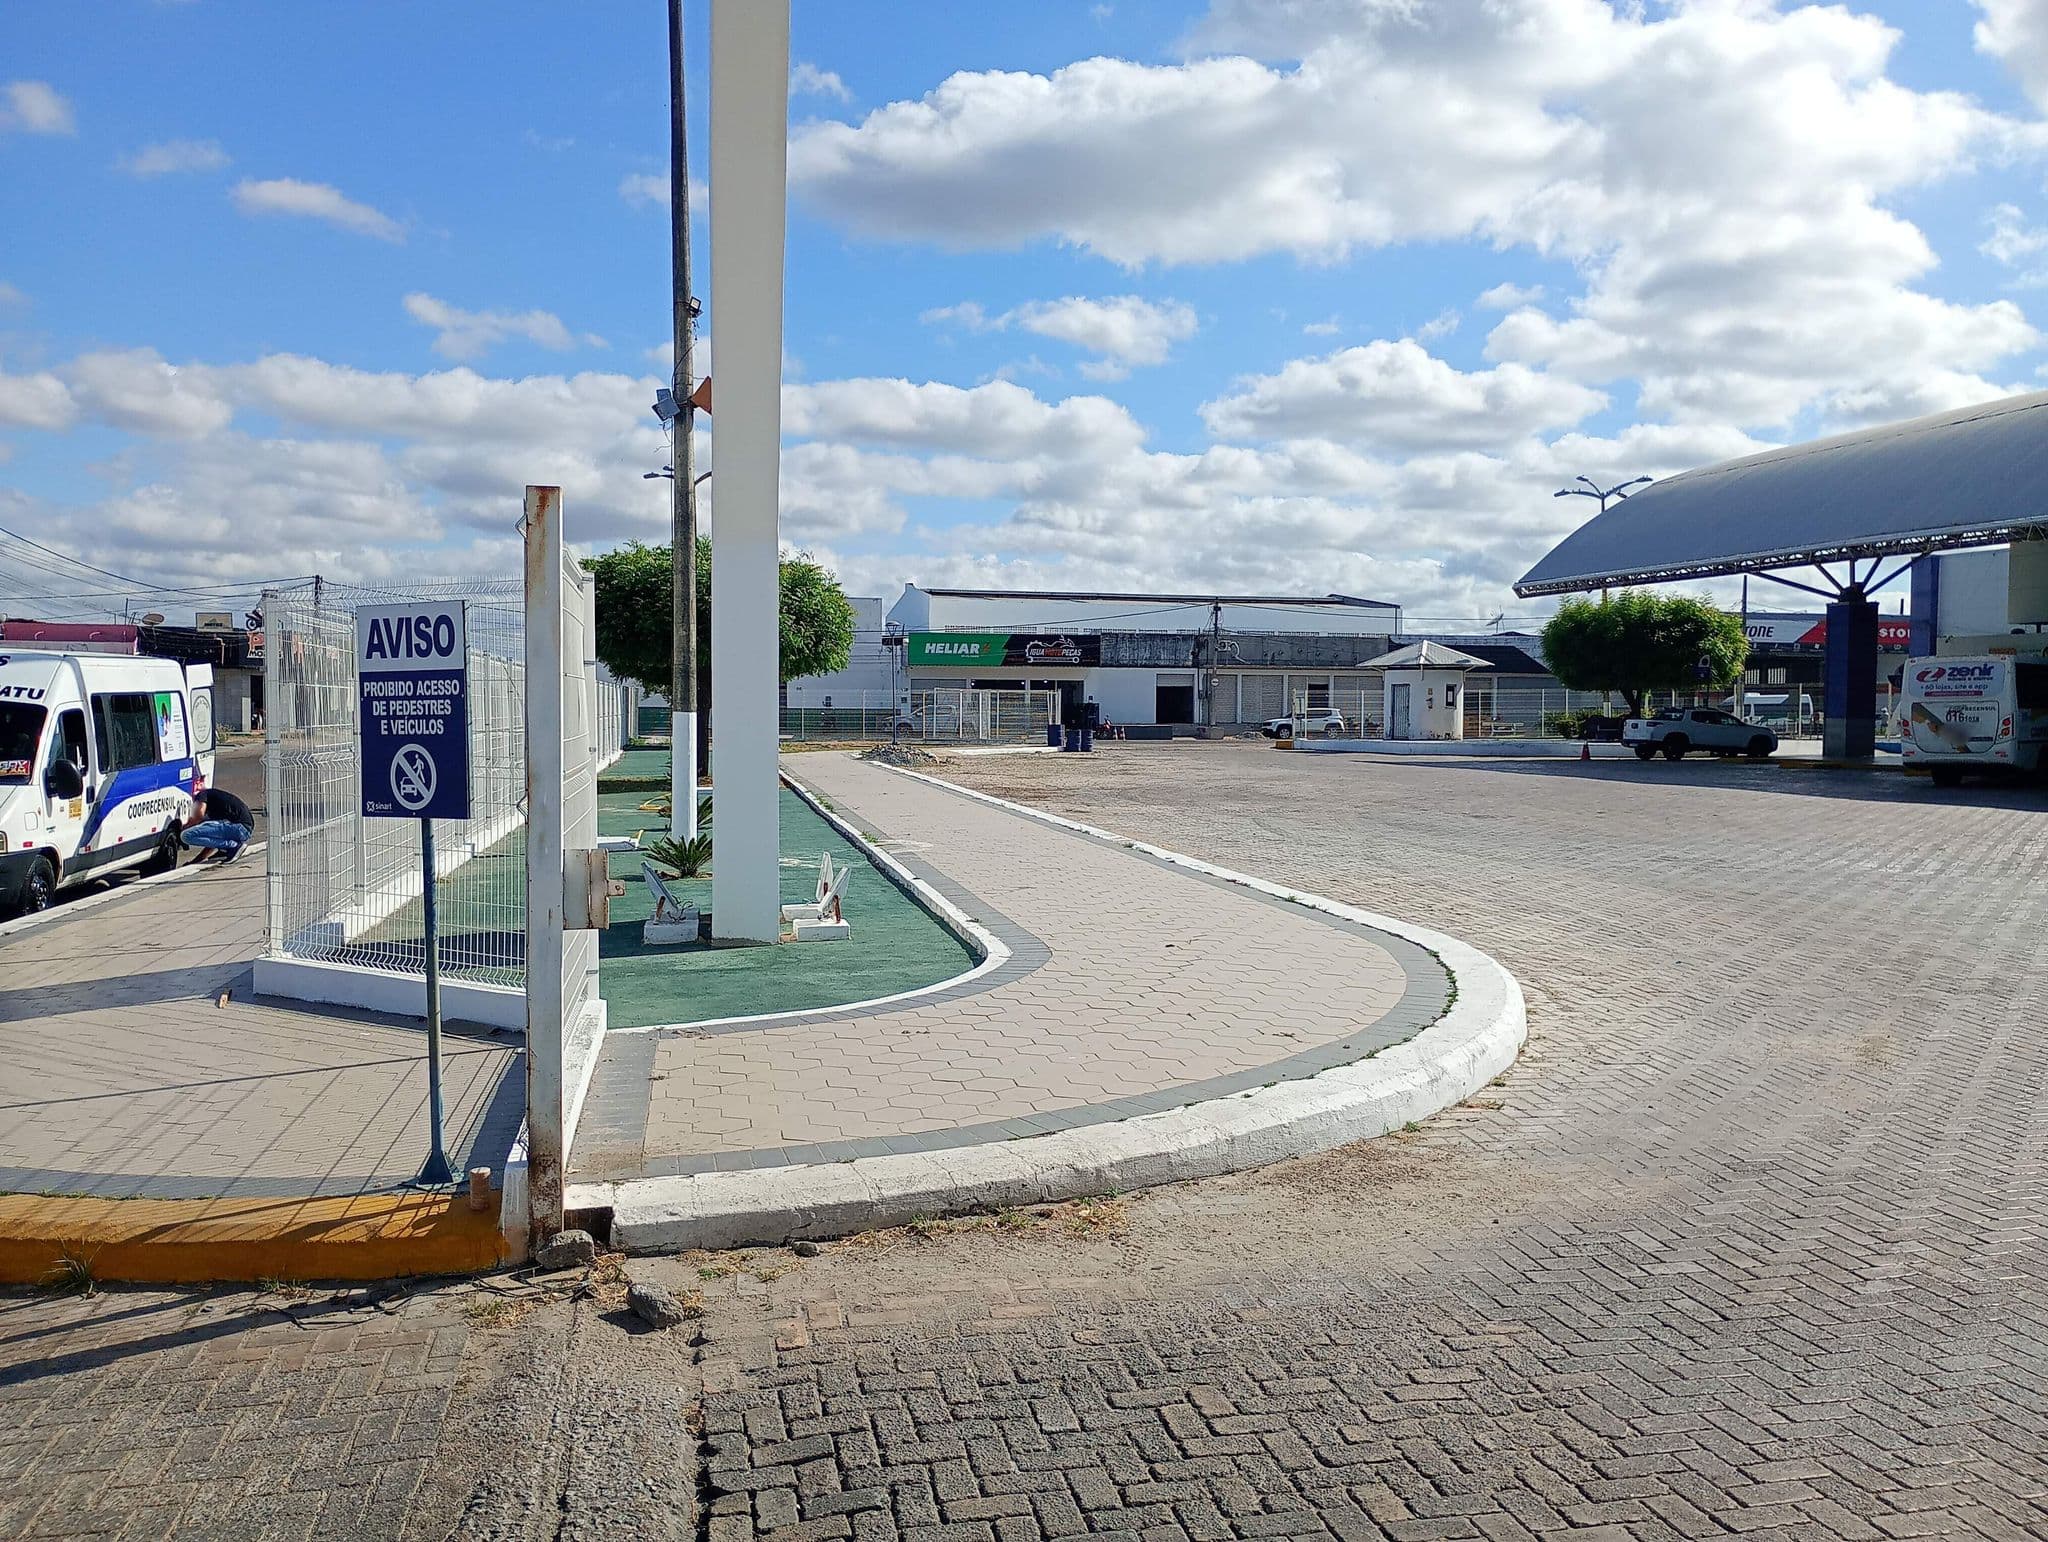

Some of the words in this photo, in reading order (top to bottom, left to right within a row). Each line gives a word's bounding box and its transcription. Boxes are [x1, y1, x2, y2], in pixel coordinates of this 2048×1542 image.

[365, 614, 455, 660] AVISO
[925, 643, 980, 654] HELIAR
[1947, 663, 1994, 677] zenir
[364, 681, 413, 697] PROIBIDO
[416, 680, 460, 695] ACESSO
[372, 700, 386, 716] DE
[389, 700, 451, 715] PEDESTRES
[381, 720, 388, 735] E
[391, 716, 444, 735] VEÍCULOS
[127, 796, 177, 819] COOPRECENSUL
